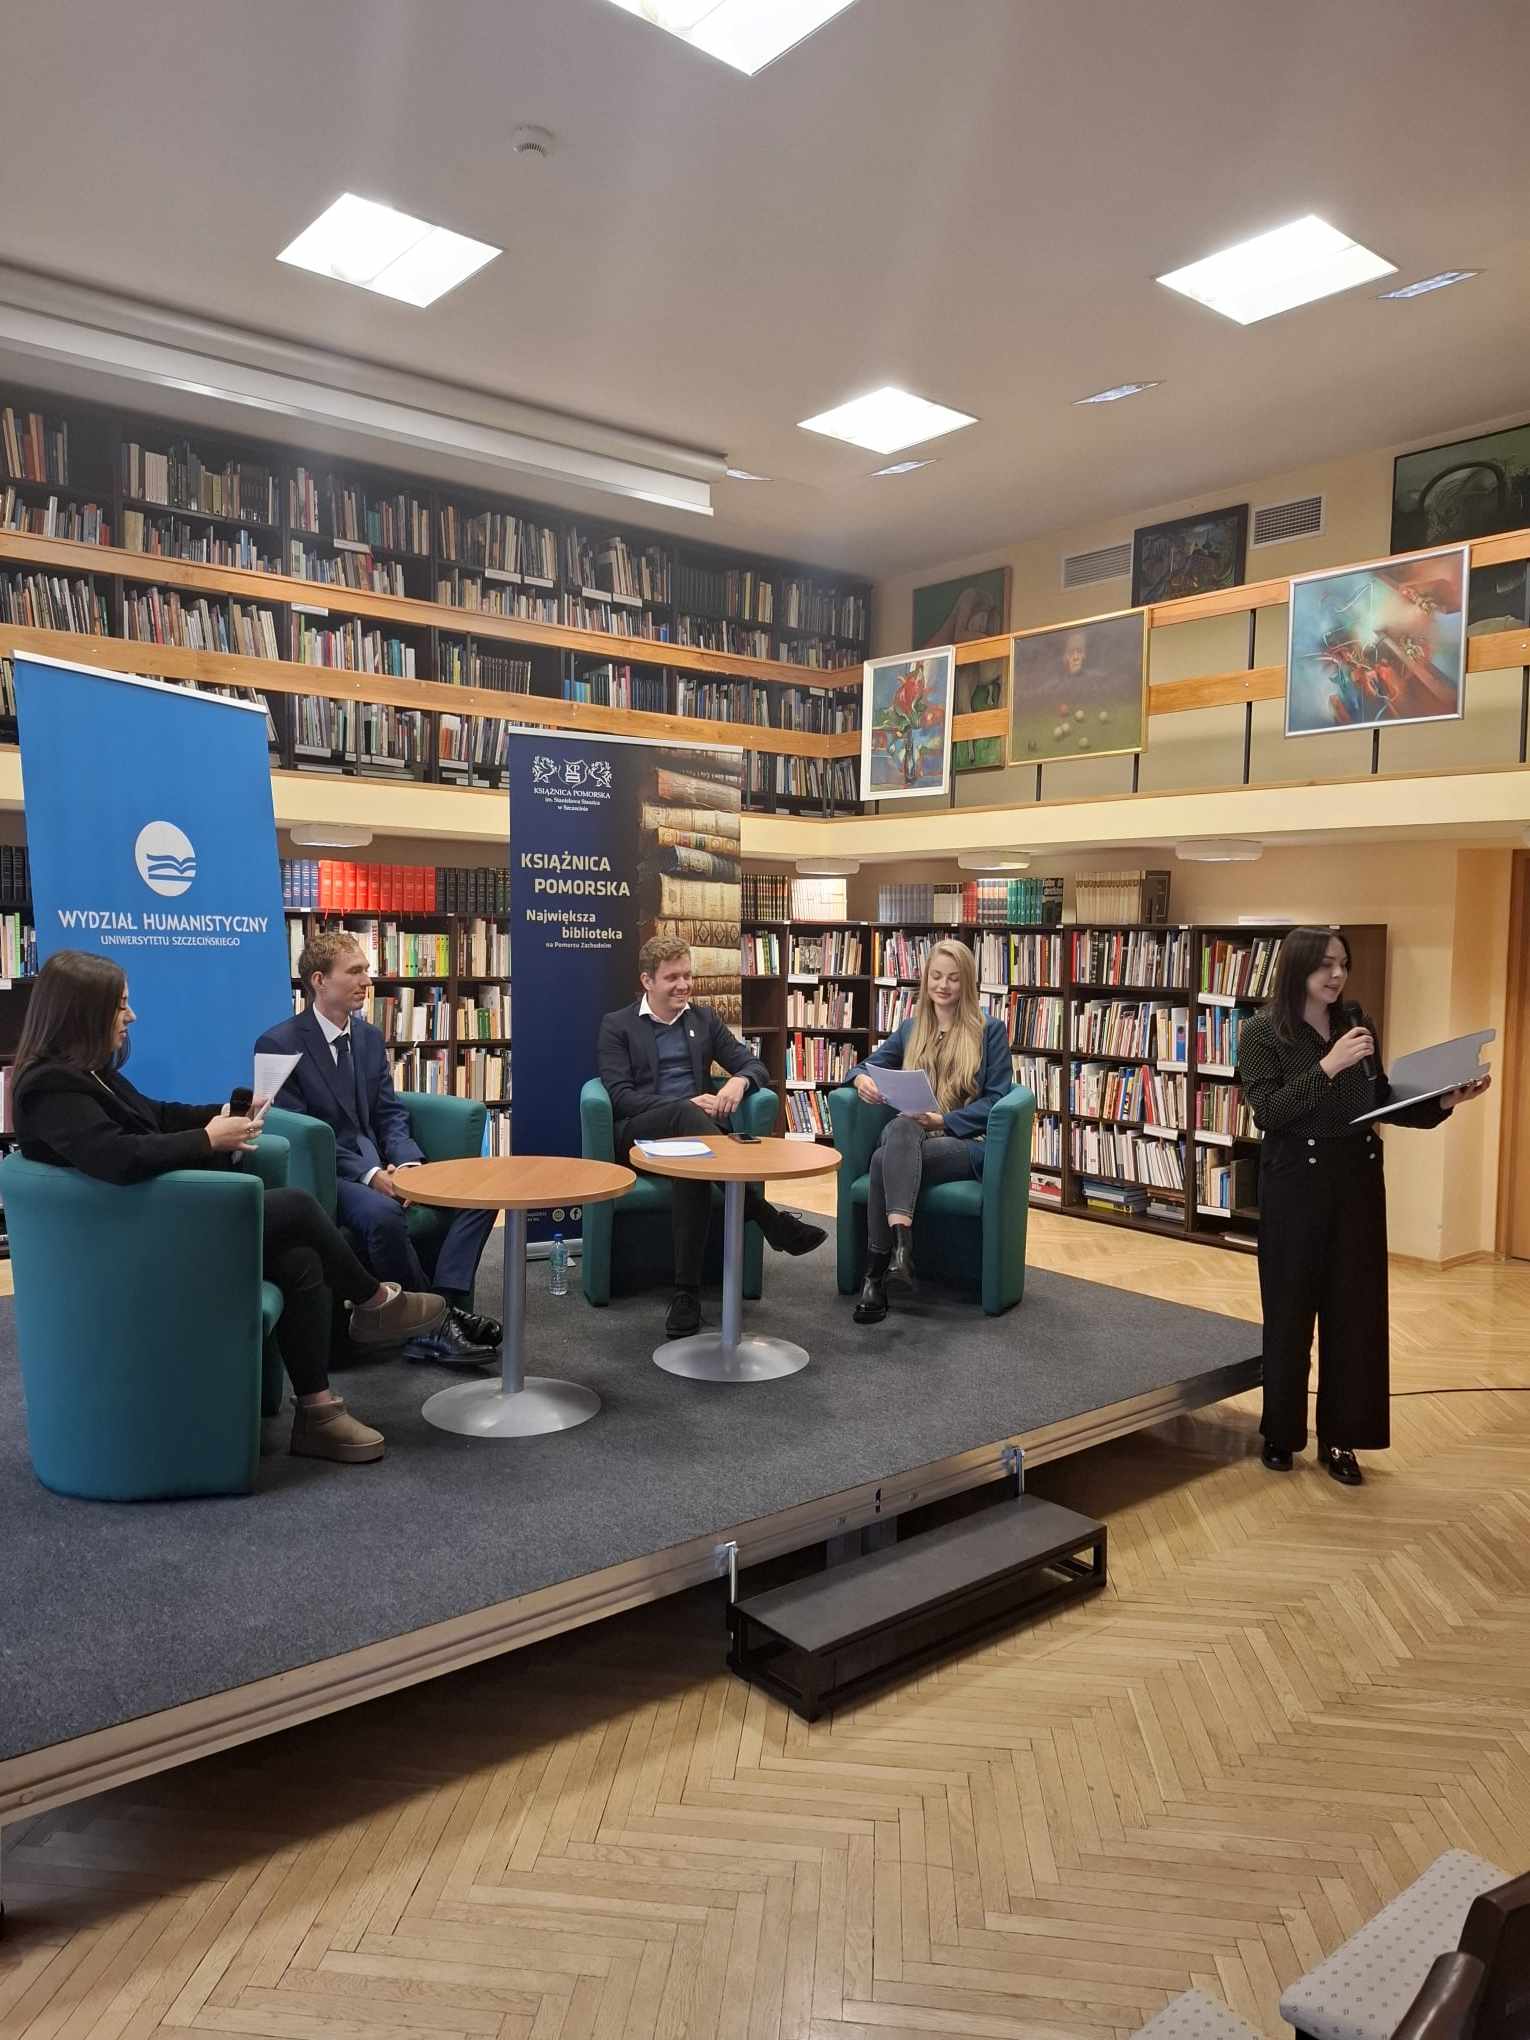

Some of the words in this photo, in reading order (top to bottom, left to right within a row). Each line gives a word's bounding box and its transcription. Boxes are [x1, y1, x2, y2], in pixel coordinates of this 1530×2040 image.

[573, 790, 611, 799] POMORSKA
[521, 850, 611, 873] KSIĄŻNICA
[534, 878, 631, 897] POMORSKA
[58, 910, 138, 930] WYDZIAŁ
[143, 912, 268, 933] HUMANISTYCZNY
[526, 909, 597, 924] Największa
[562, 926, 623, 940] biblioteka
[101, 935, 170, 946] UNIWERSYTETU
[172, 935, 240, 947] SZCZECIŃSKIEGO
